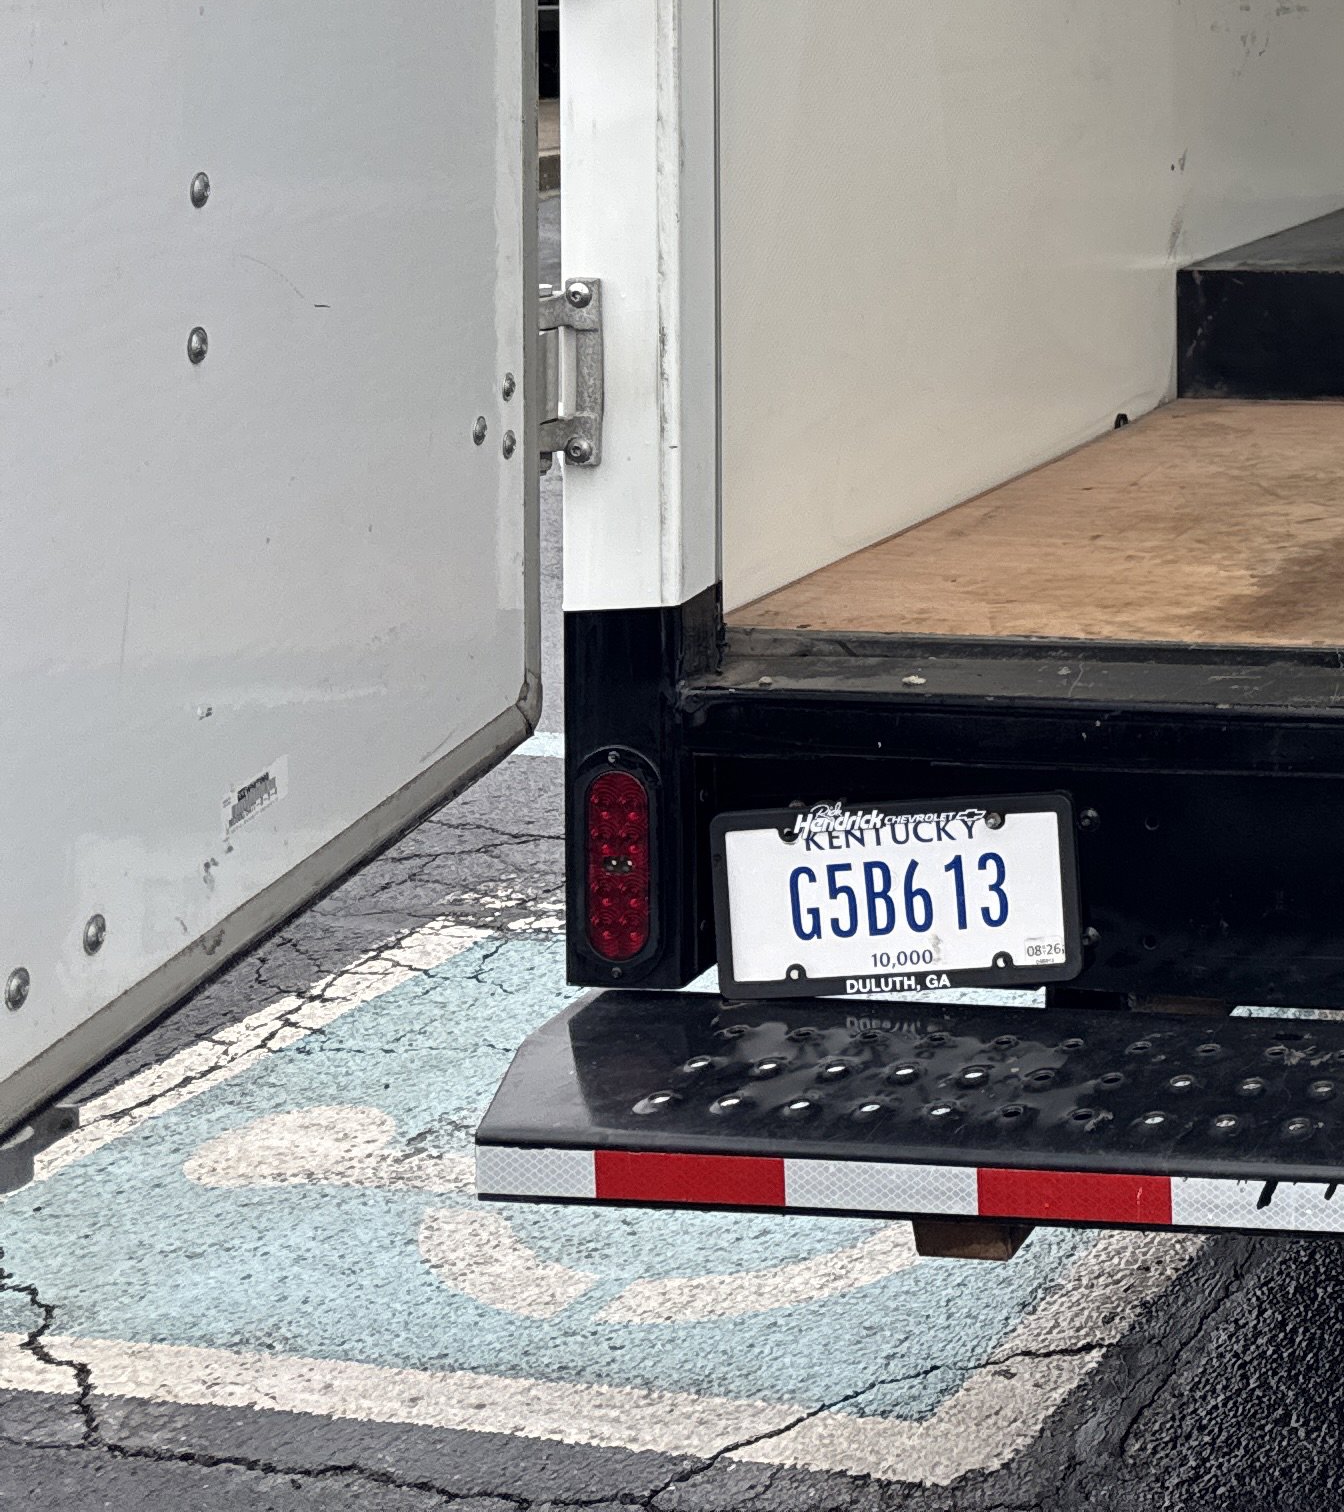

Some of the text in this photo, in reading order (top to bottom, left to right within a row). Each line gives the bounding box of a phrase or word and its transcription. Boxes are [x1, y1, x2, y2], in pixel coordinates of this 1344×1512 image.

[794, 802, 956, 838] Rick Hendrick CHEVROLET
[805, 820, 976, 851] KENTUCKY
[790, 852, 1009, 941] G5B613
[871, 949, 933, 969] 10,000
[846, 973, 951, 993] DULUTH, GA
